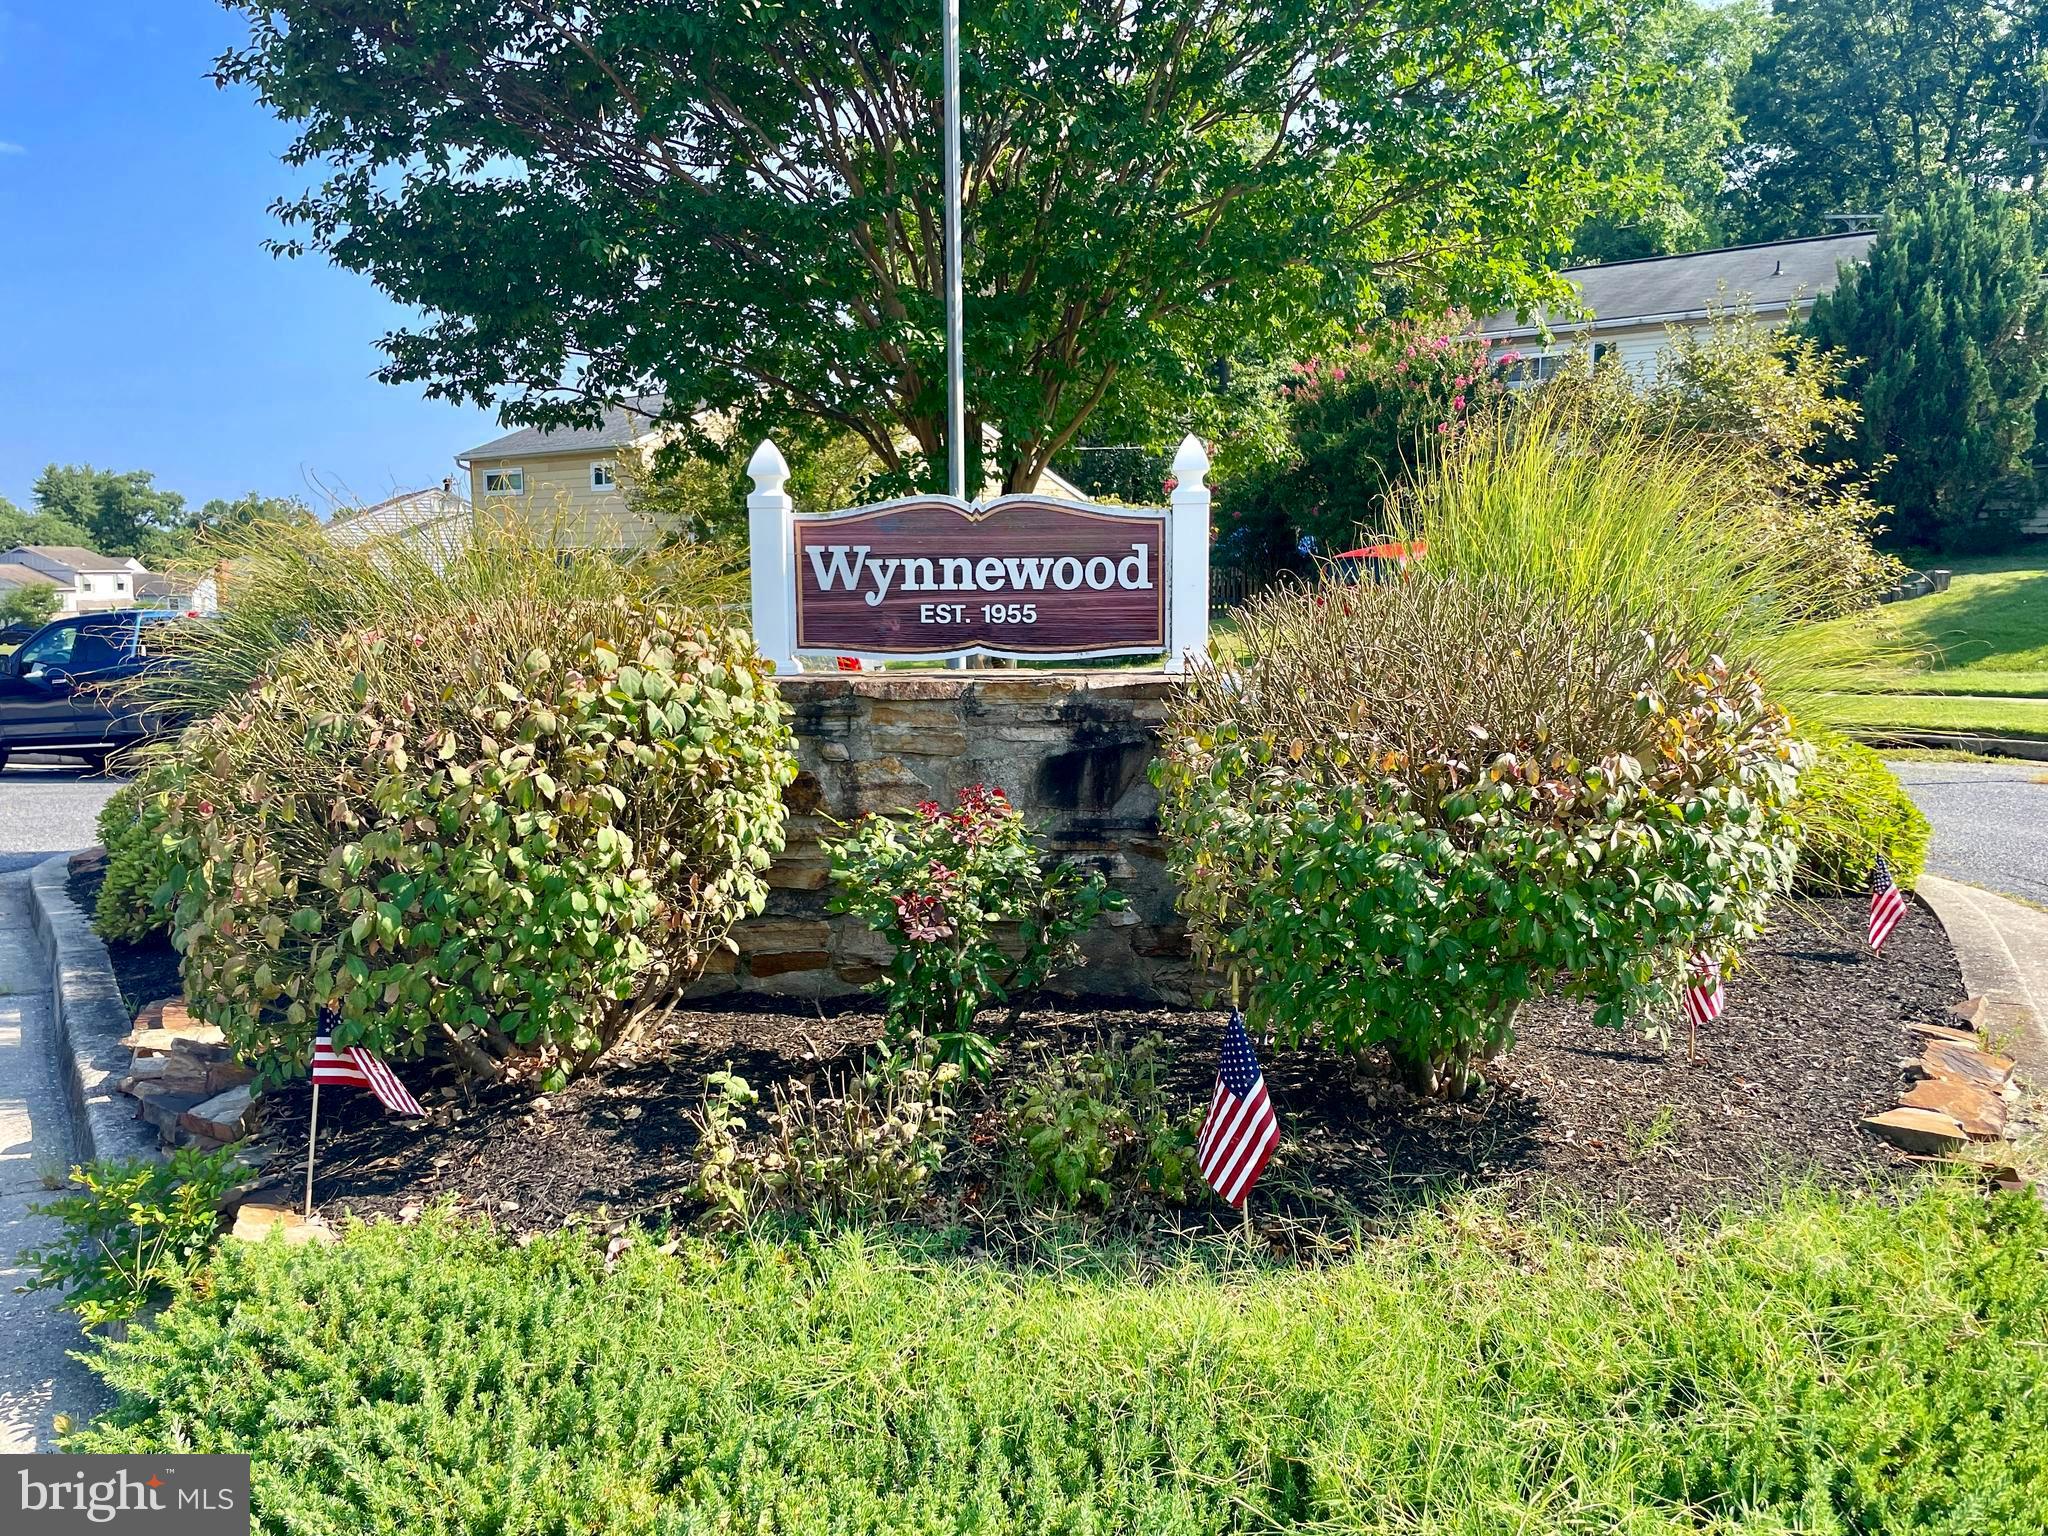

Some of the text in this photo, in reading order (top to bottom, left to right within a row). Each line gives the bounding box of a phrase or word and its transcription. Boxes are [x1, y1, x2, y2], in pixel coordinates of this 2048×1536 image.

[805, 543, 1153, 606] Wynnewood
[920, 603, 1038, 624] EST. 1955
